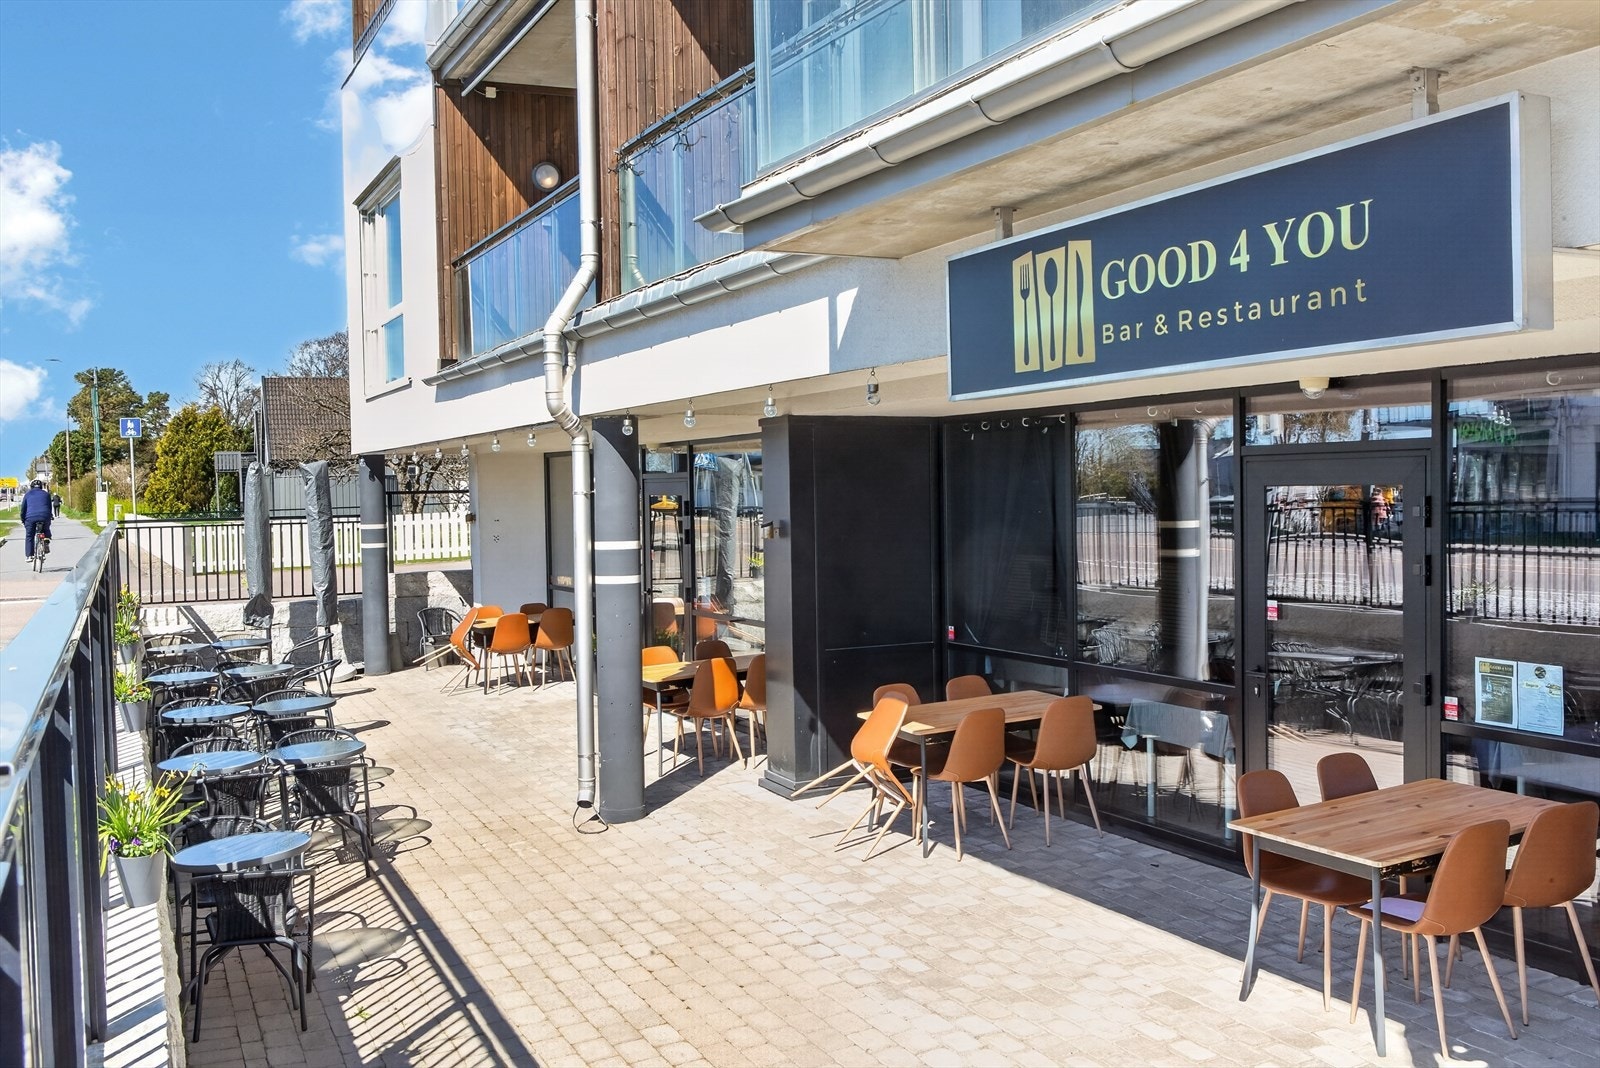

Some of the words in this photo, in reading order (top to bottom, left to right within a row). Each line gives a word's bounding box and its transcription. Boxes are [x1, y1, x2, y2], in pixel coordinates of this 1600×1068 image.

[1101, 240, 1217, 300] GOOD
[1230, 229, 1250, 273] 4
[1263, 200, 1373, 266] YOU
[1103, 322, 1143, 344] Bar
[1154, 313, 1169, 336] &
[1179, 278, 1367, 332] Restaurant
